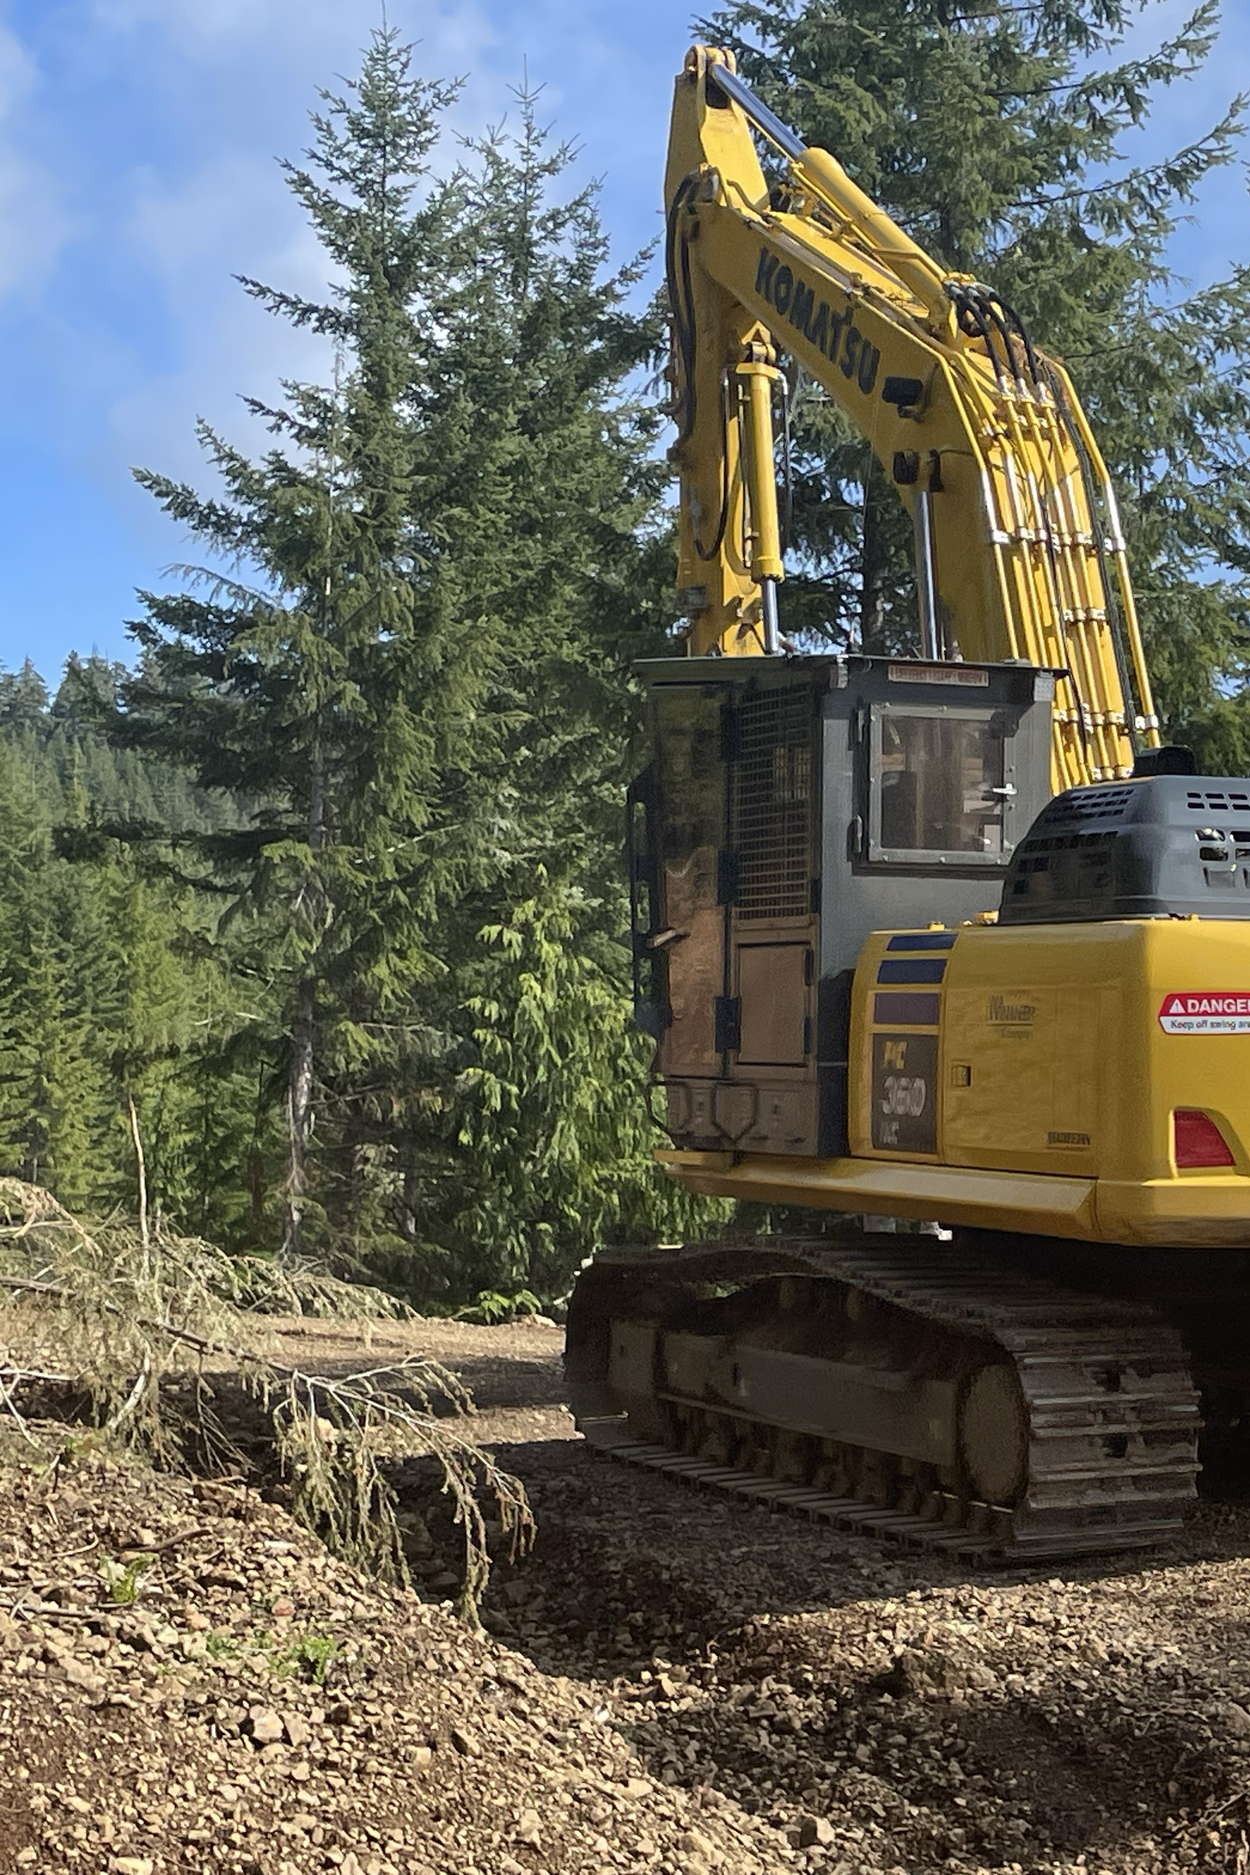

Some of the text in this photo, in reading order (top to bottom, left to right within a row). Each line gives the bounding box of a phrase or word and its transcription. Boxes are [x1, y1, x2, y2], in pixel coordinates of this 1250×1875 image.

[755, 244, 881, 395] KOMATSU
[1170, 1020, 1194, 1030] Keep
[1196, 1019, 1208, 1028] off
